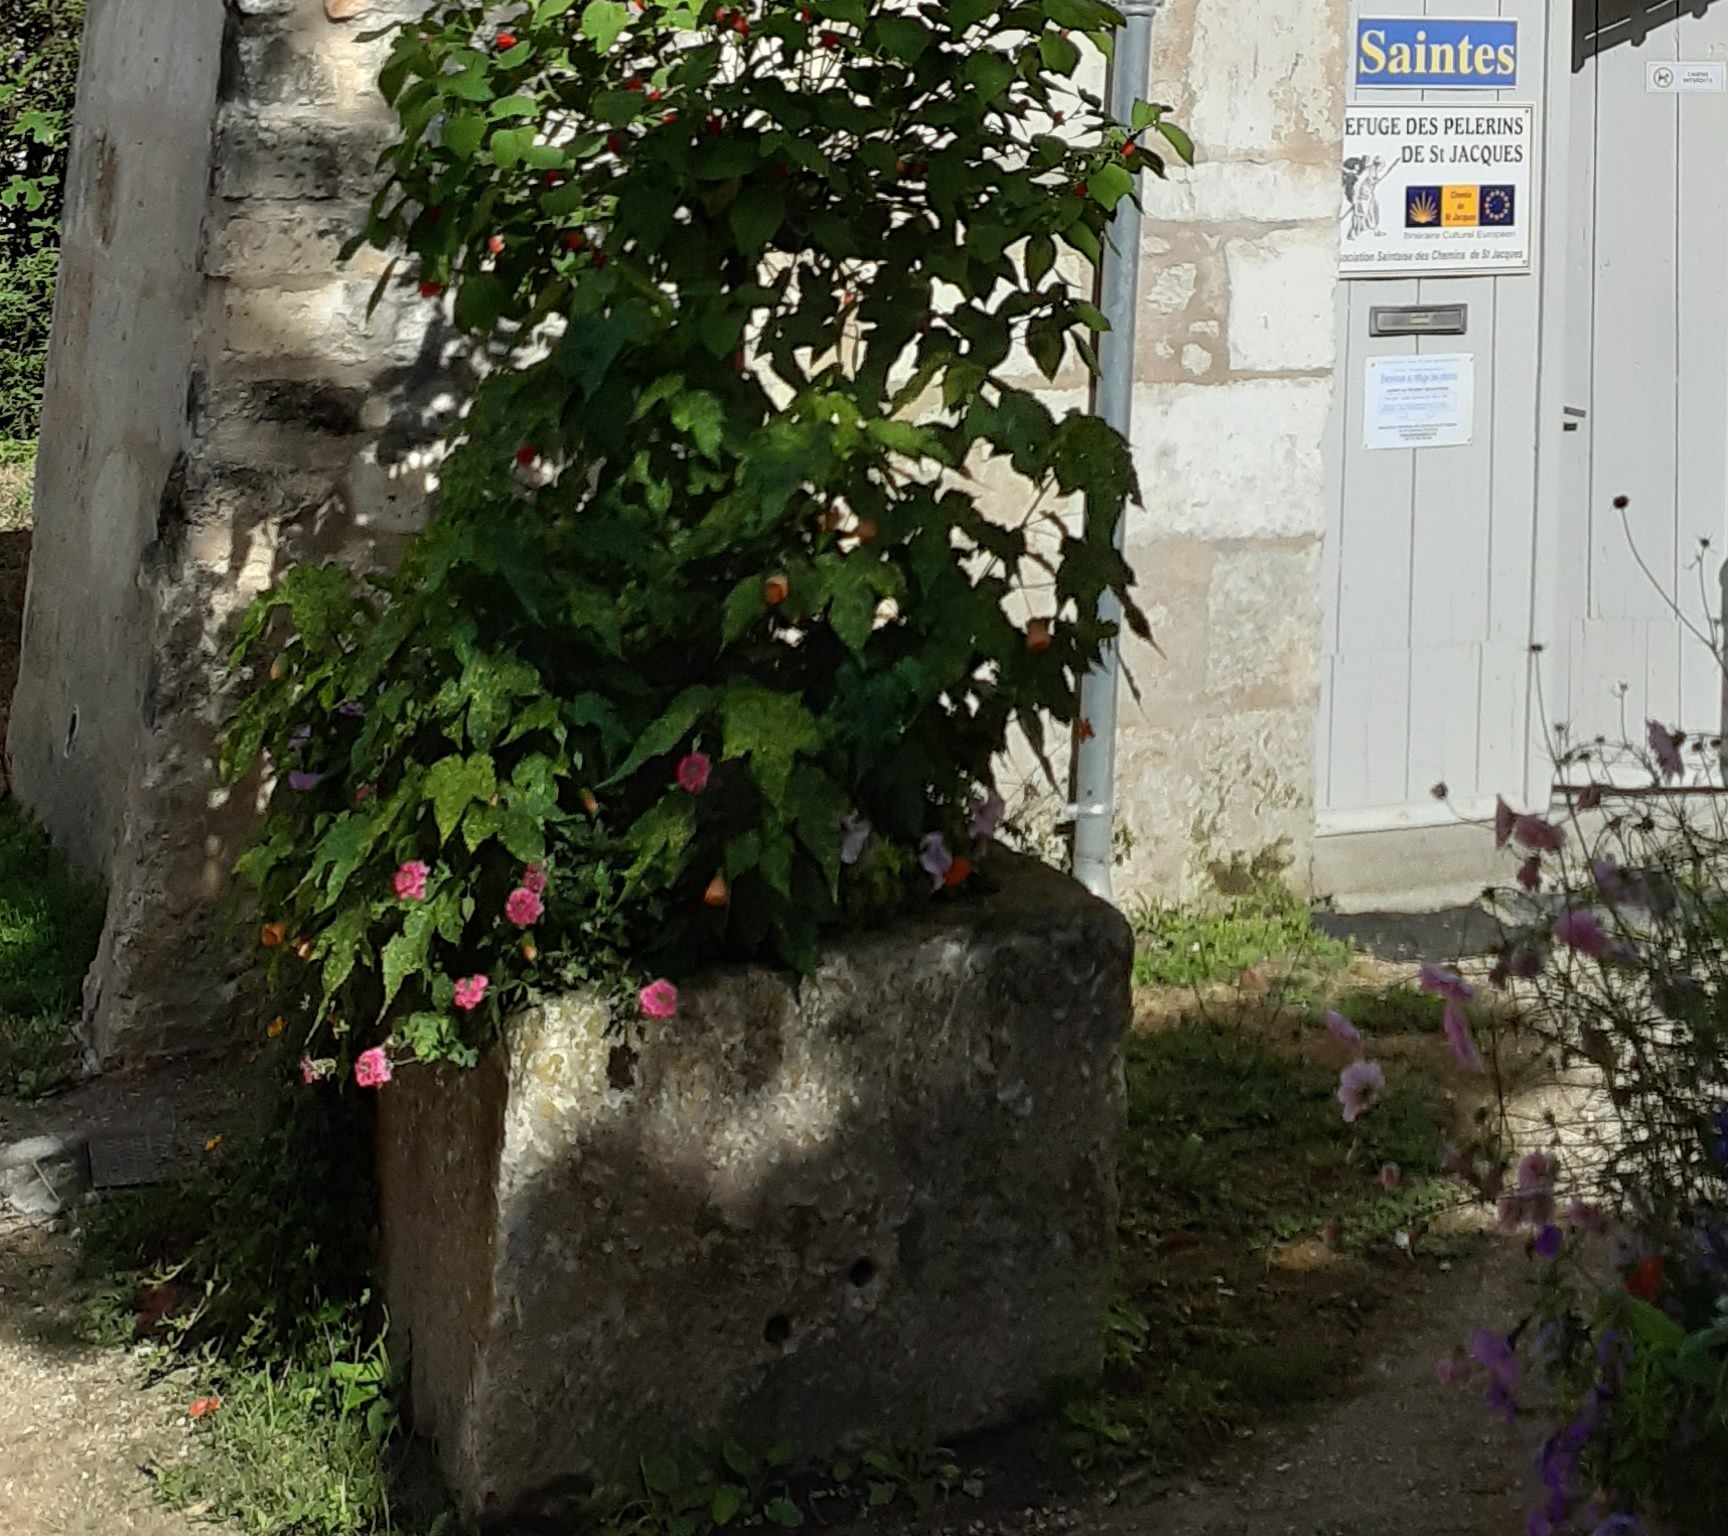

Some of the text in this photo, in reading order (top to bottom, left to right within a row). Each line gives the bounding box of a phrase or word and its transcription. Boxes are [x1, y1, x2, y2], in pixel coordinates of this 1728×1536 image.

[1359, 29, 1515, 75] Saintes
[1345, 116, 1523, 136] EFUGE DES PELERINS
[1401, 144, 1523, 167] DE St JACQUES
[1415, 250, 1429, 261] des
[1470, 249, 1480, 259] de
[1491, 249, 1523, 261] Jacques
